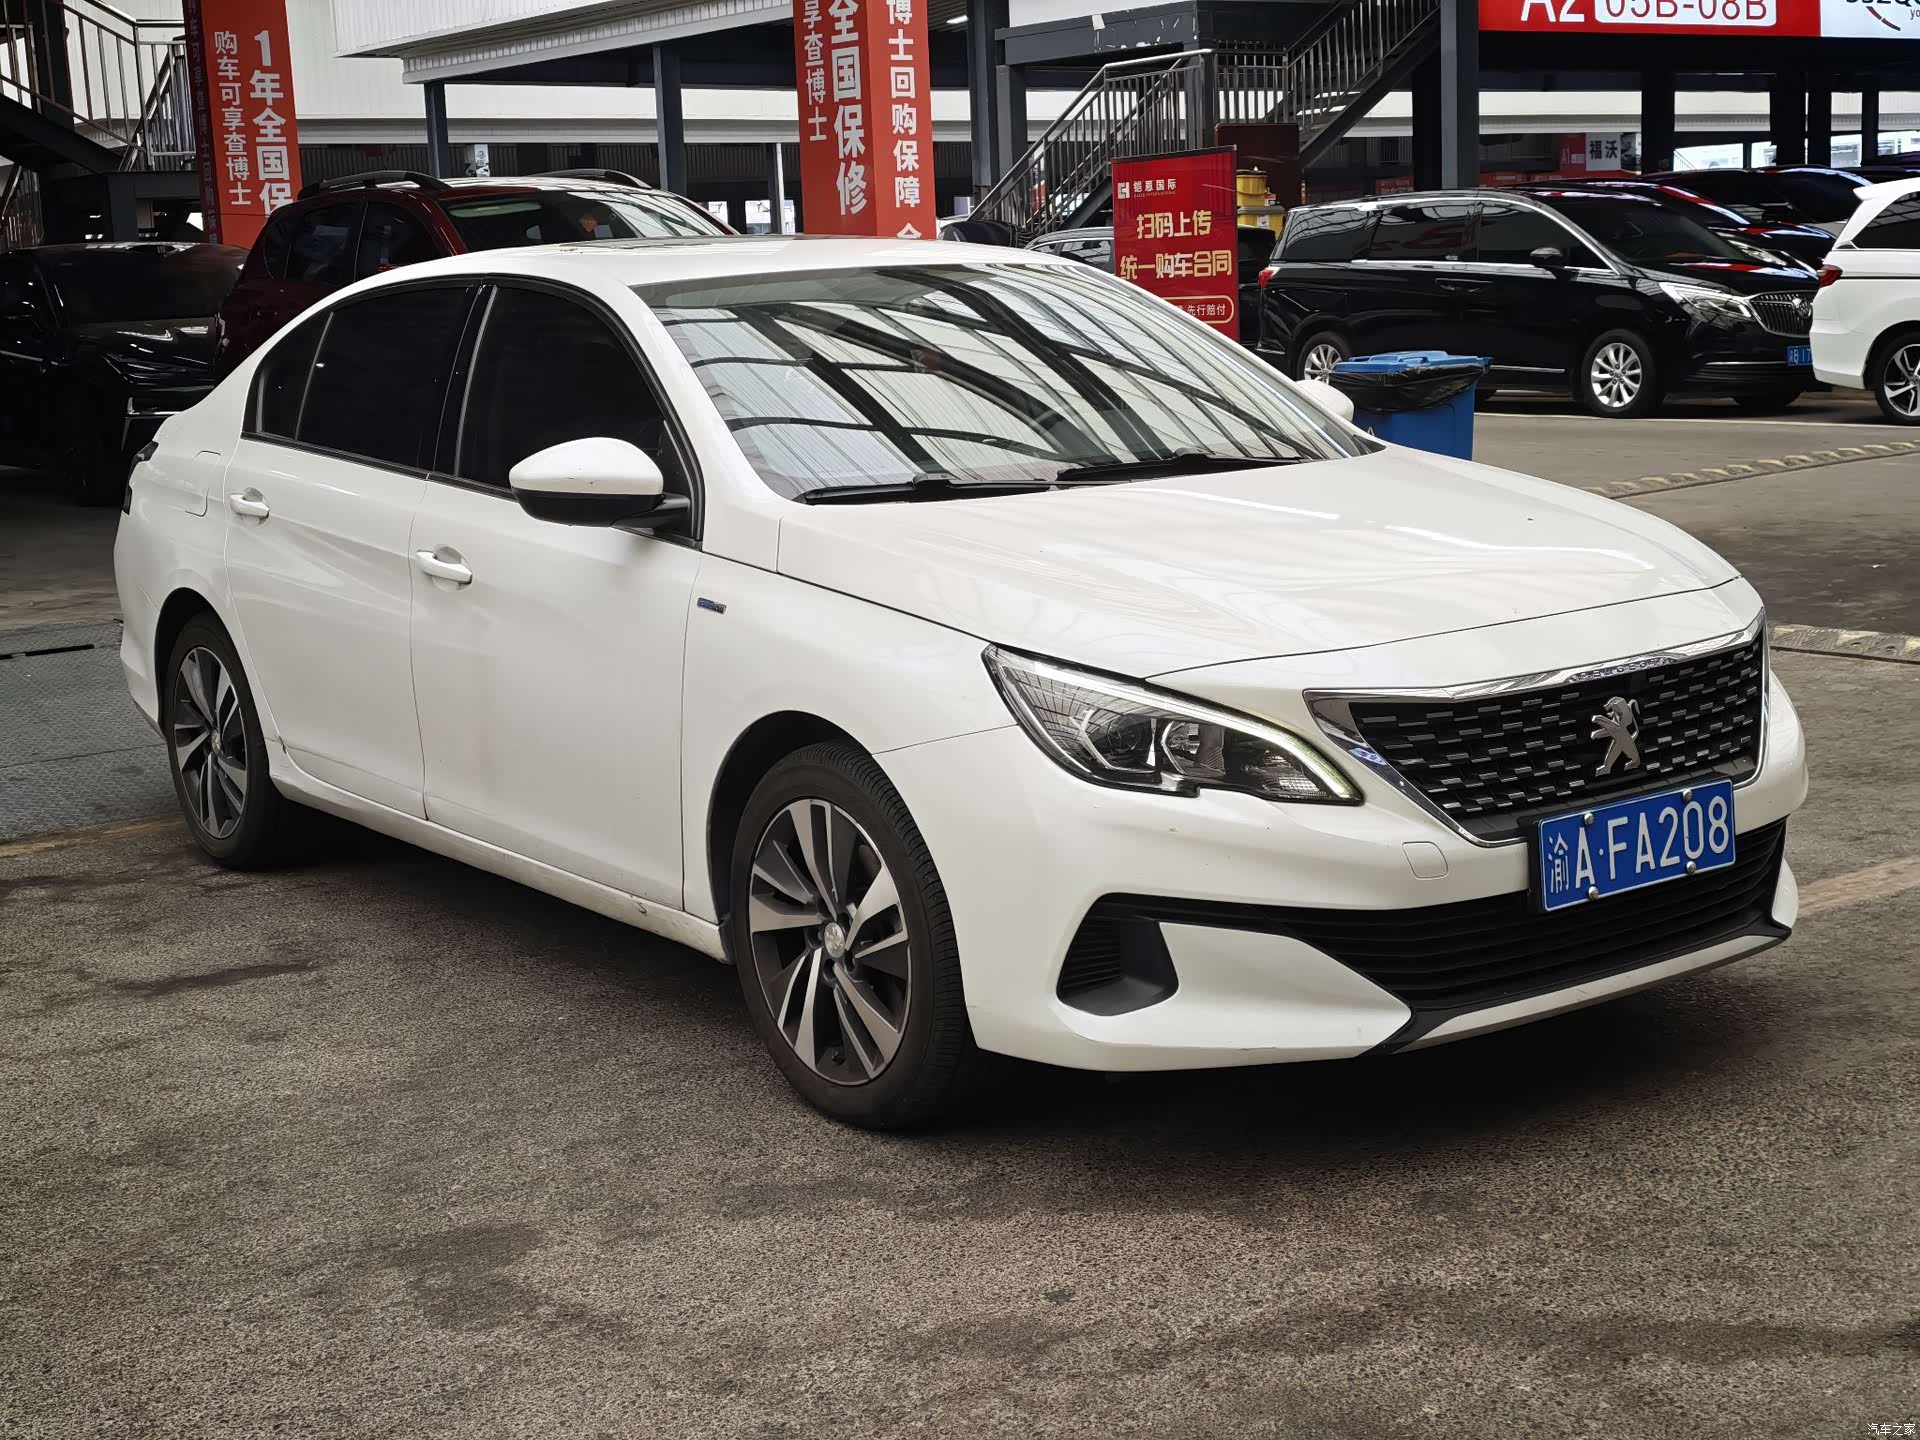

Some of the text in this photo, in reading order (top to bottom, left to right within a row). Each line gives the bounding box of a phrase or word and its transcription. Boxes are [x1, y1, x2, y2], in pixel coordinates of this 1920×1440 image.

[214, 31, 252, 205] 购车可享查博士
[828, 0, 868, 216] 全国保修
[886, 0, 921, 208] 博士回购保障
[1120, 250, 1232, 280] 统一购车合同
[1136, 209, 1212, 239] 扫码上传
